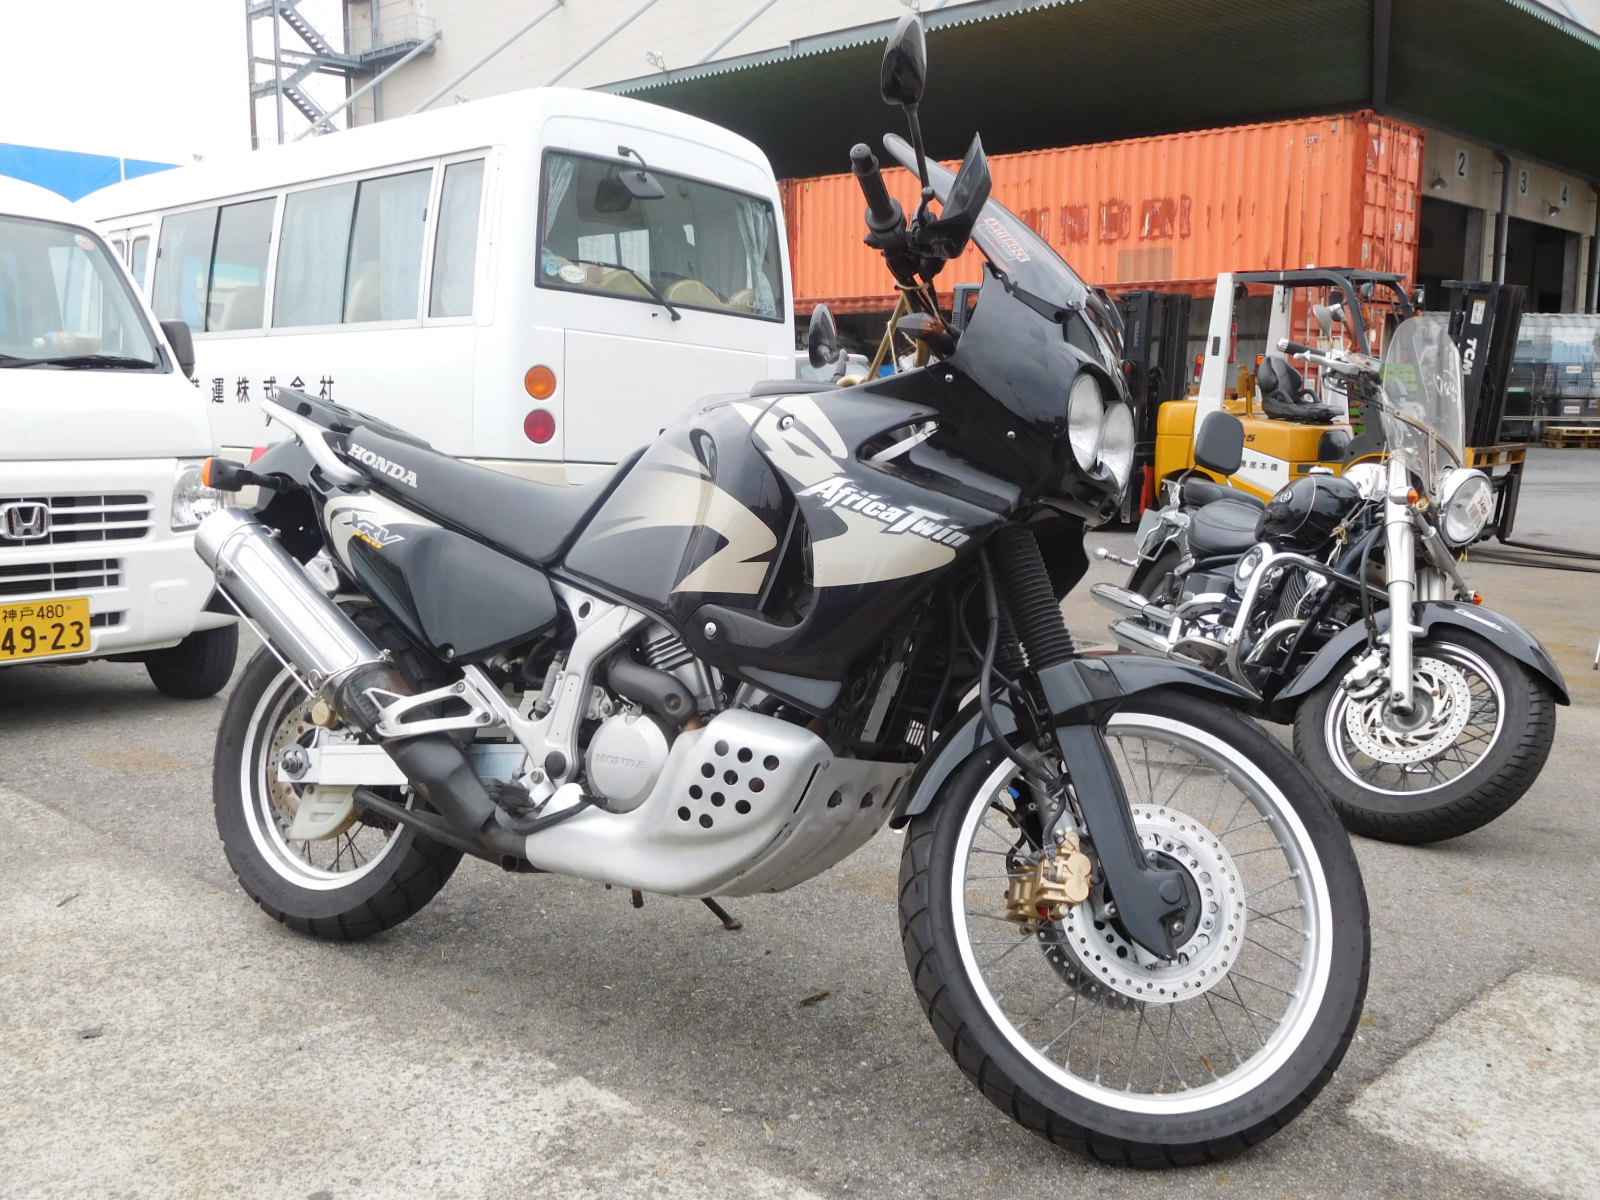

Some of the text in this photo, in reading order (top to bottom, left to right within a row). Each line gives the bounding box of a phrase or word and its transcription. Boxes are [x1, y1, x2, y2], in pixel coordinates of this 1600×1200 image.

[985, 218, 1030, 261] ANTISHOCK
[1462, 338, 1478, 375] TCM
[190, 374, 335, 404] 運株式会社
[347, 442, 418, 489] HONDA
[342, 510, 405, 546] XRV
[2, 604, 64, 623] 神戸 480
[2, 621, 85, 655] 49-23
